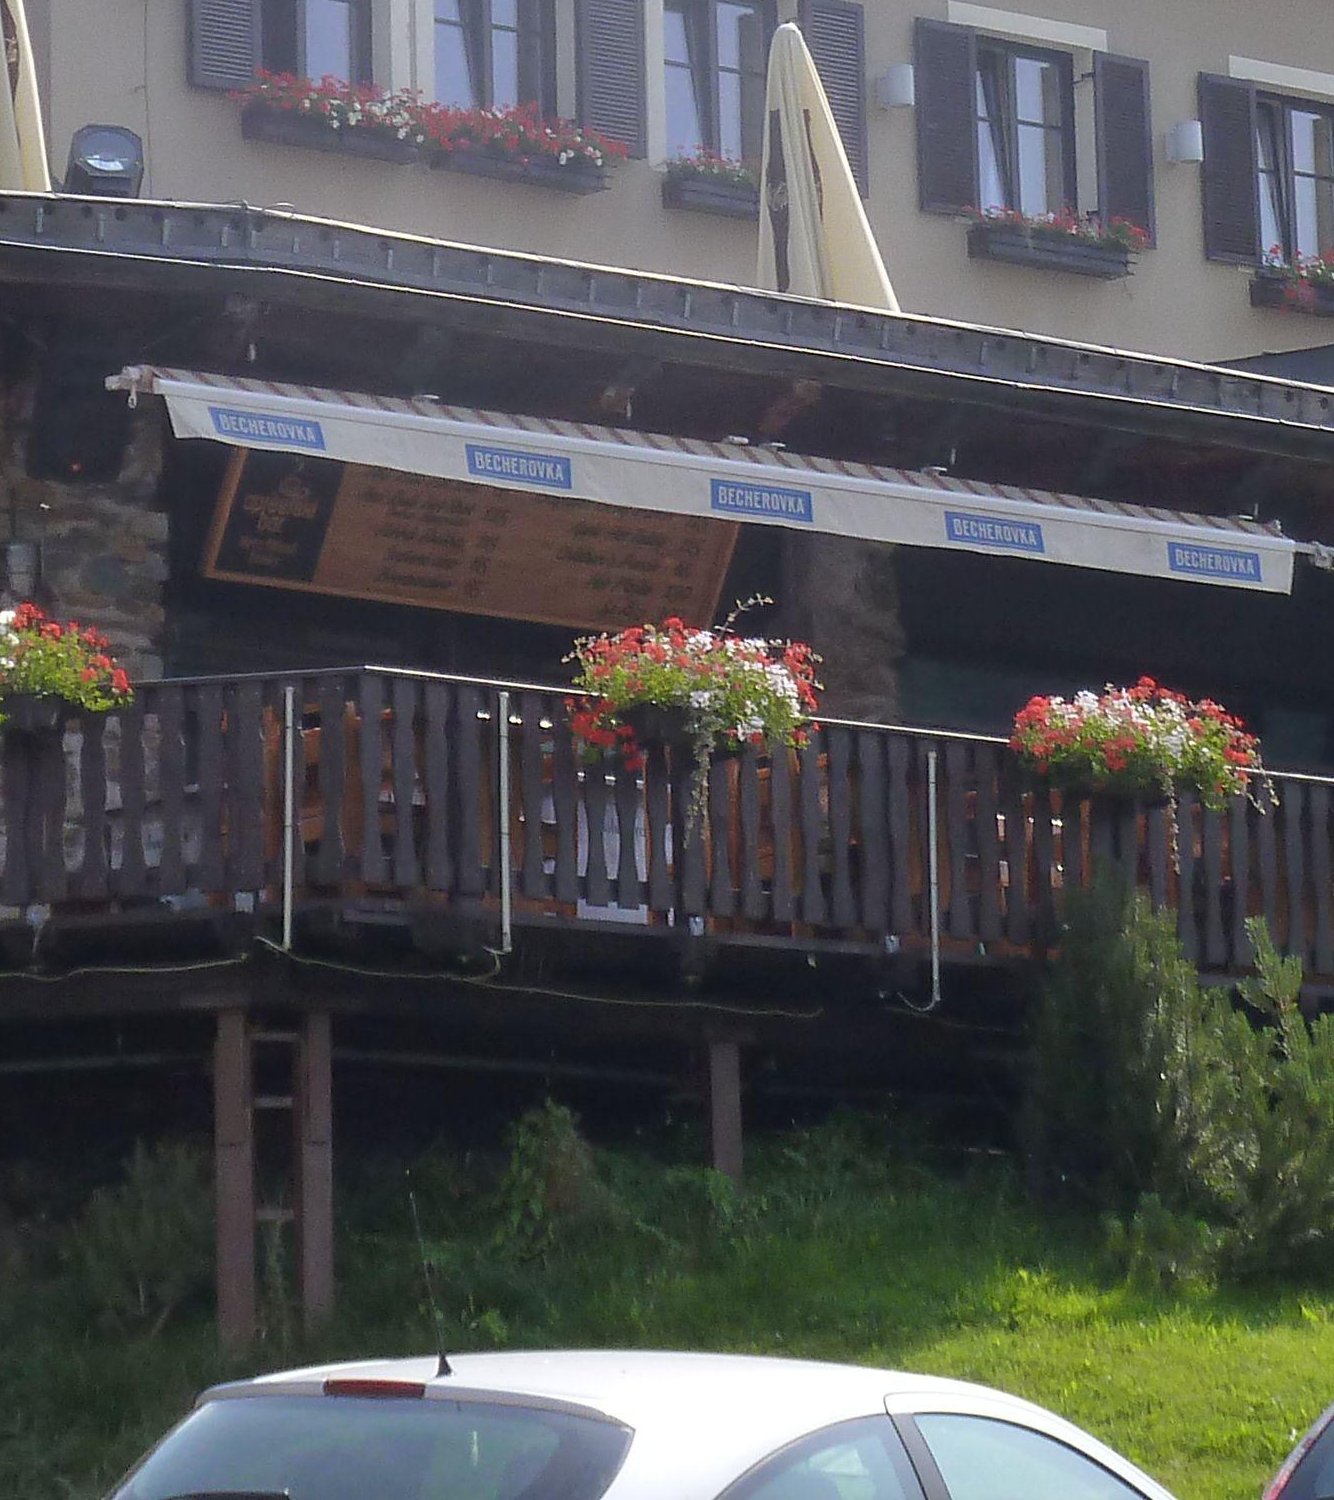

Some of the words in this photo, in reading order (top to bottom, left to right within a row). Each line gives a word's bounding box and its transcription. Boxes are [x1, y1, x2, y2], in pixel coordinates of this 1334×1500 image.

[219, 413, 316, 443] BECHEROVKA
[474, 450, 564, 482] BECHEROVKA
[718, 484, 805, 515] BECHEROVKA
[954, 518, 1037, 546] BECHEROVKA
[1175, 548, 1255, 574] BECHEROVKA
